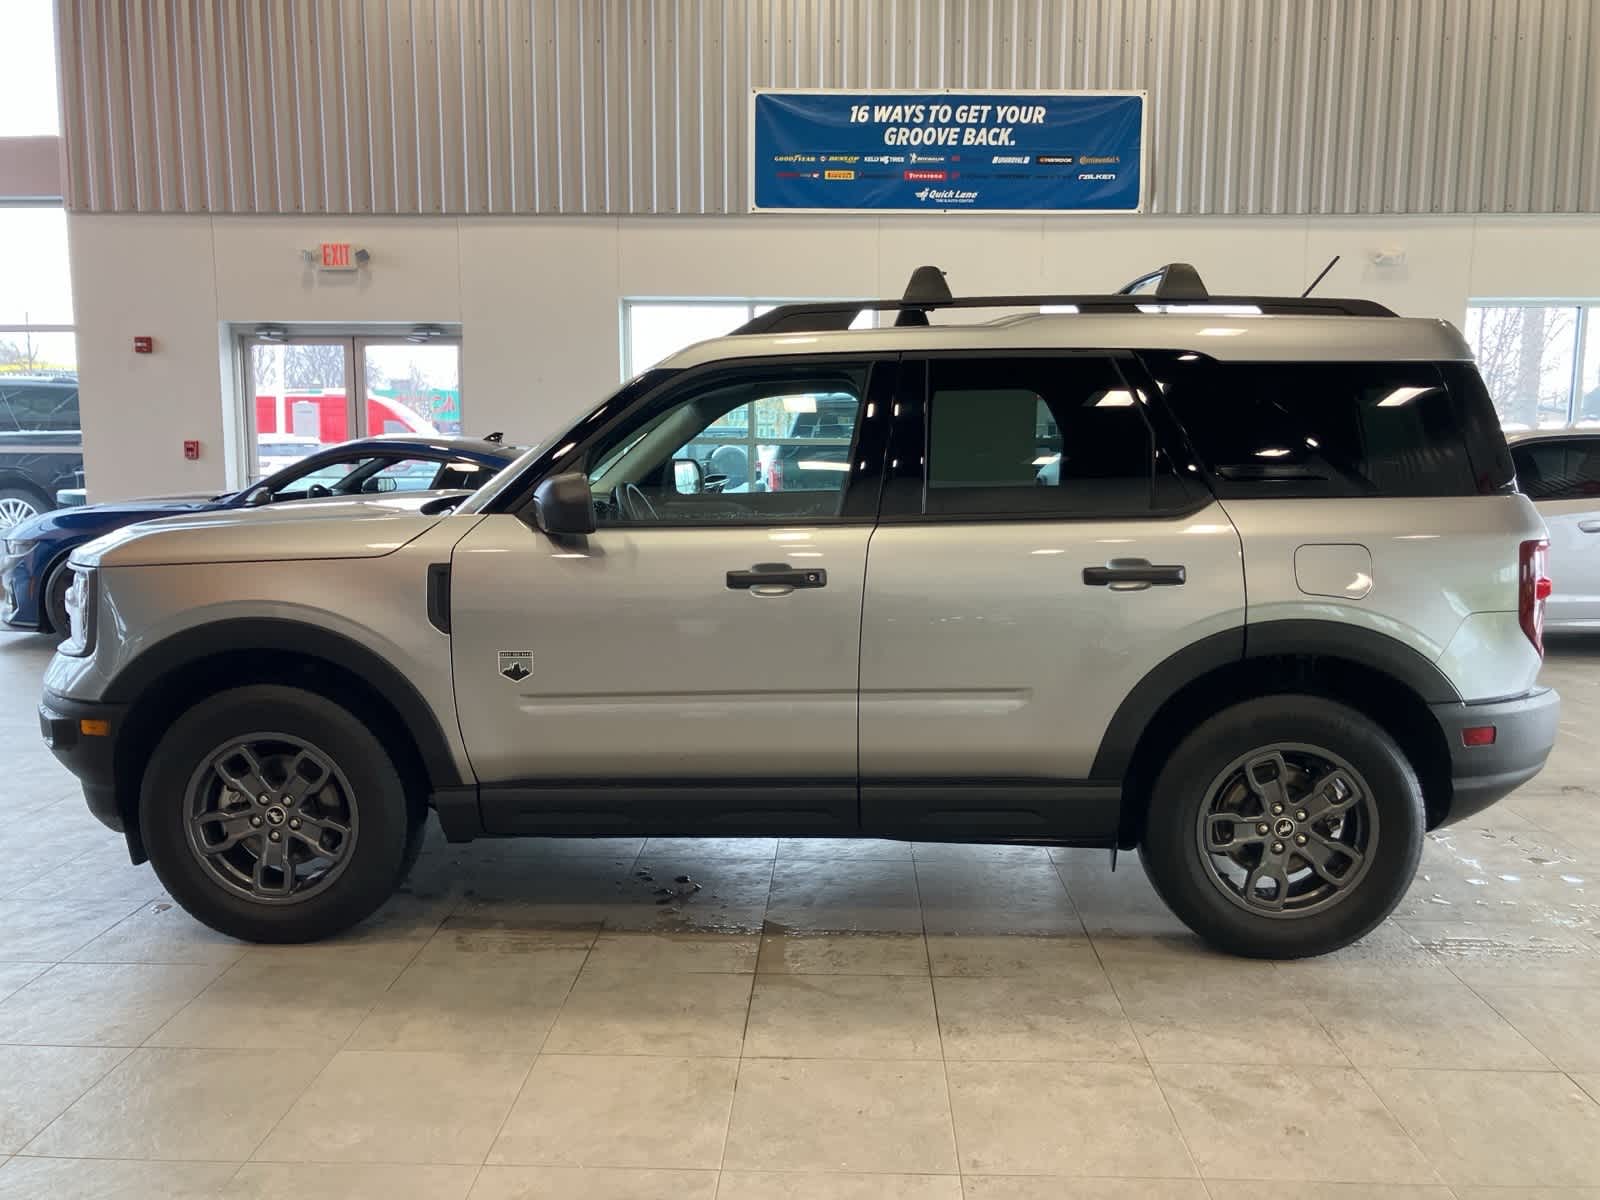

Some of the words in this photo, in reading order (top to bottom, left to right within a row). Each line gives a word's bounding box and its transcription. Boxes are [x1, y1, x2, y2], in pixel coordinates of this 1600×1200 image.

[850, 105, 870, 123] 16
[873, 105, 925, 123] WAYS
[928, 105, 952, 123] TO
[955, 105, 992, 123] GET
[995, 105, 1047, 123] YOUR
[884, 127, 960, 146] GROOVE
[962, 127, 1016, 146] BACK.
[929, 190, 953, 200] Quick
[954, 190, 978, 199] Lane
[322, 243, 351, 266] EXIT
